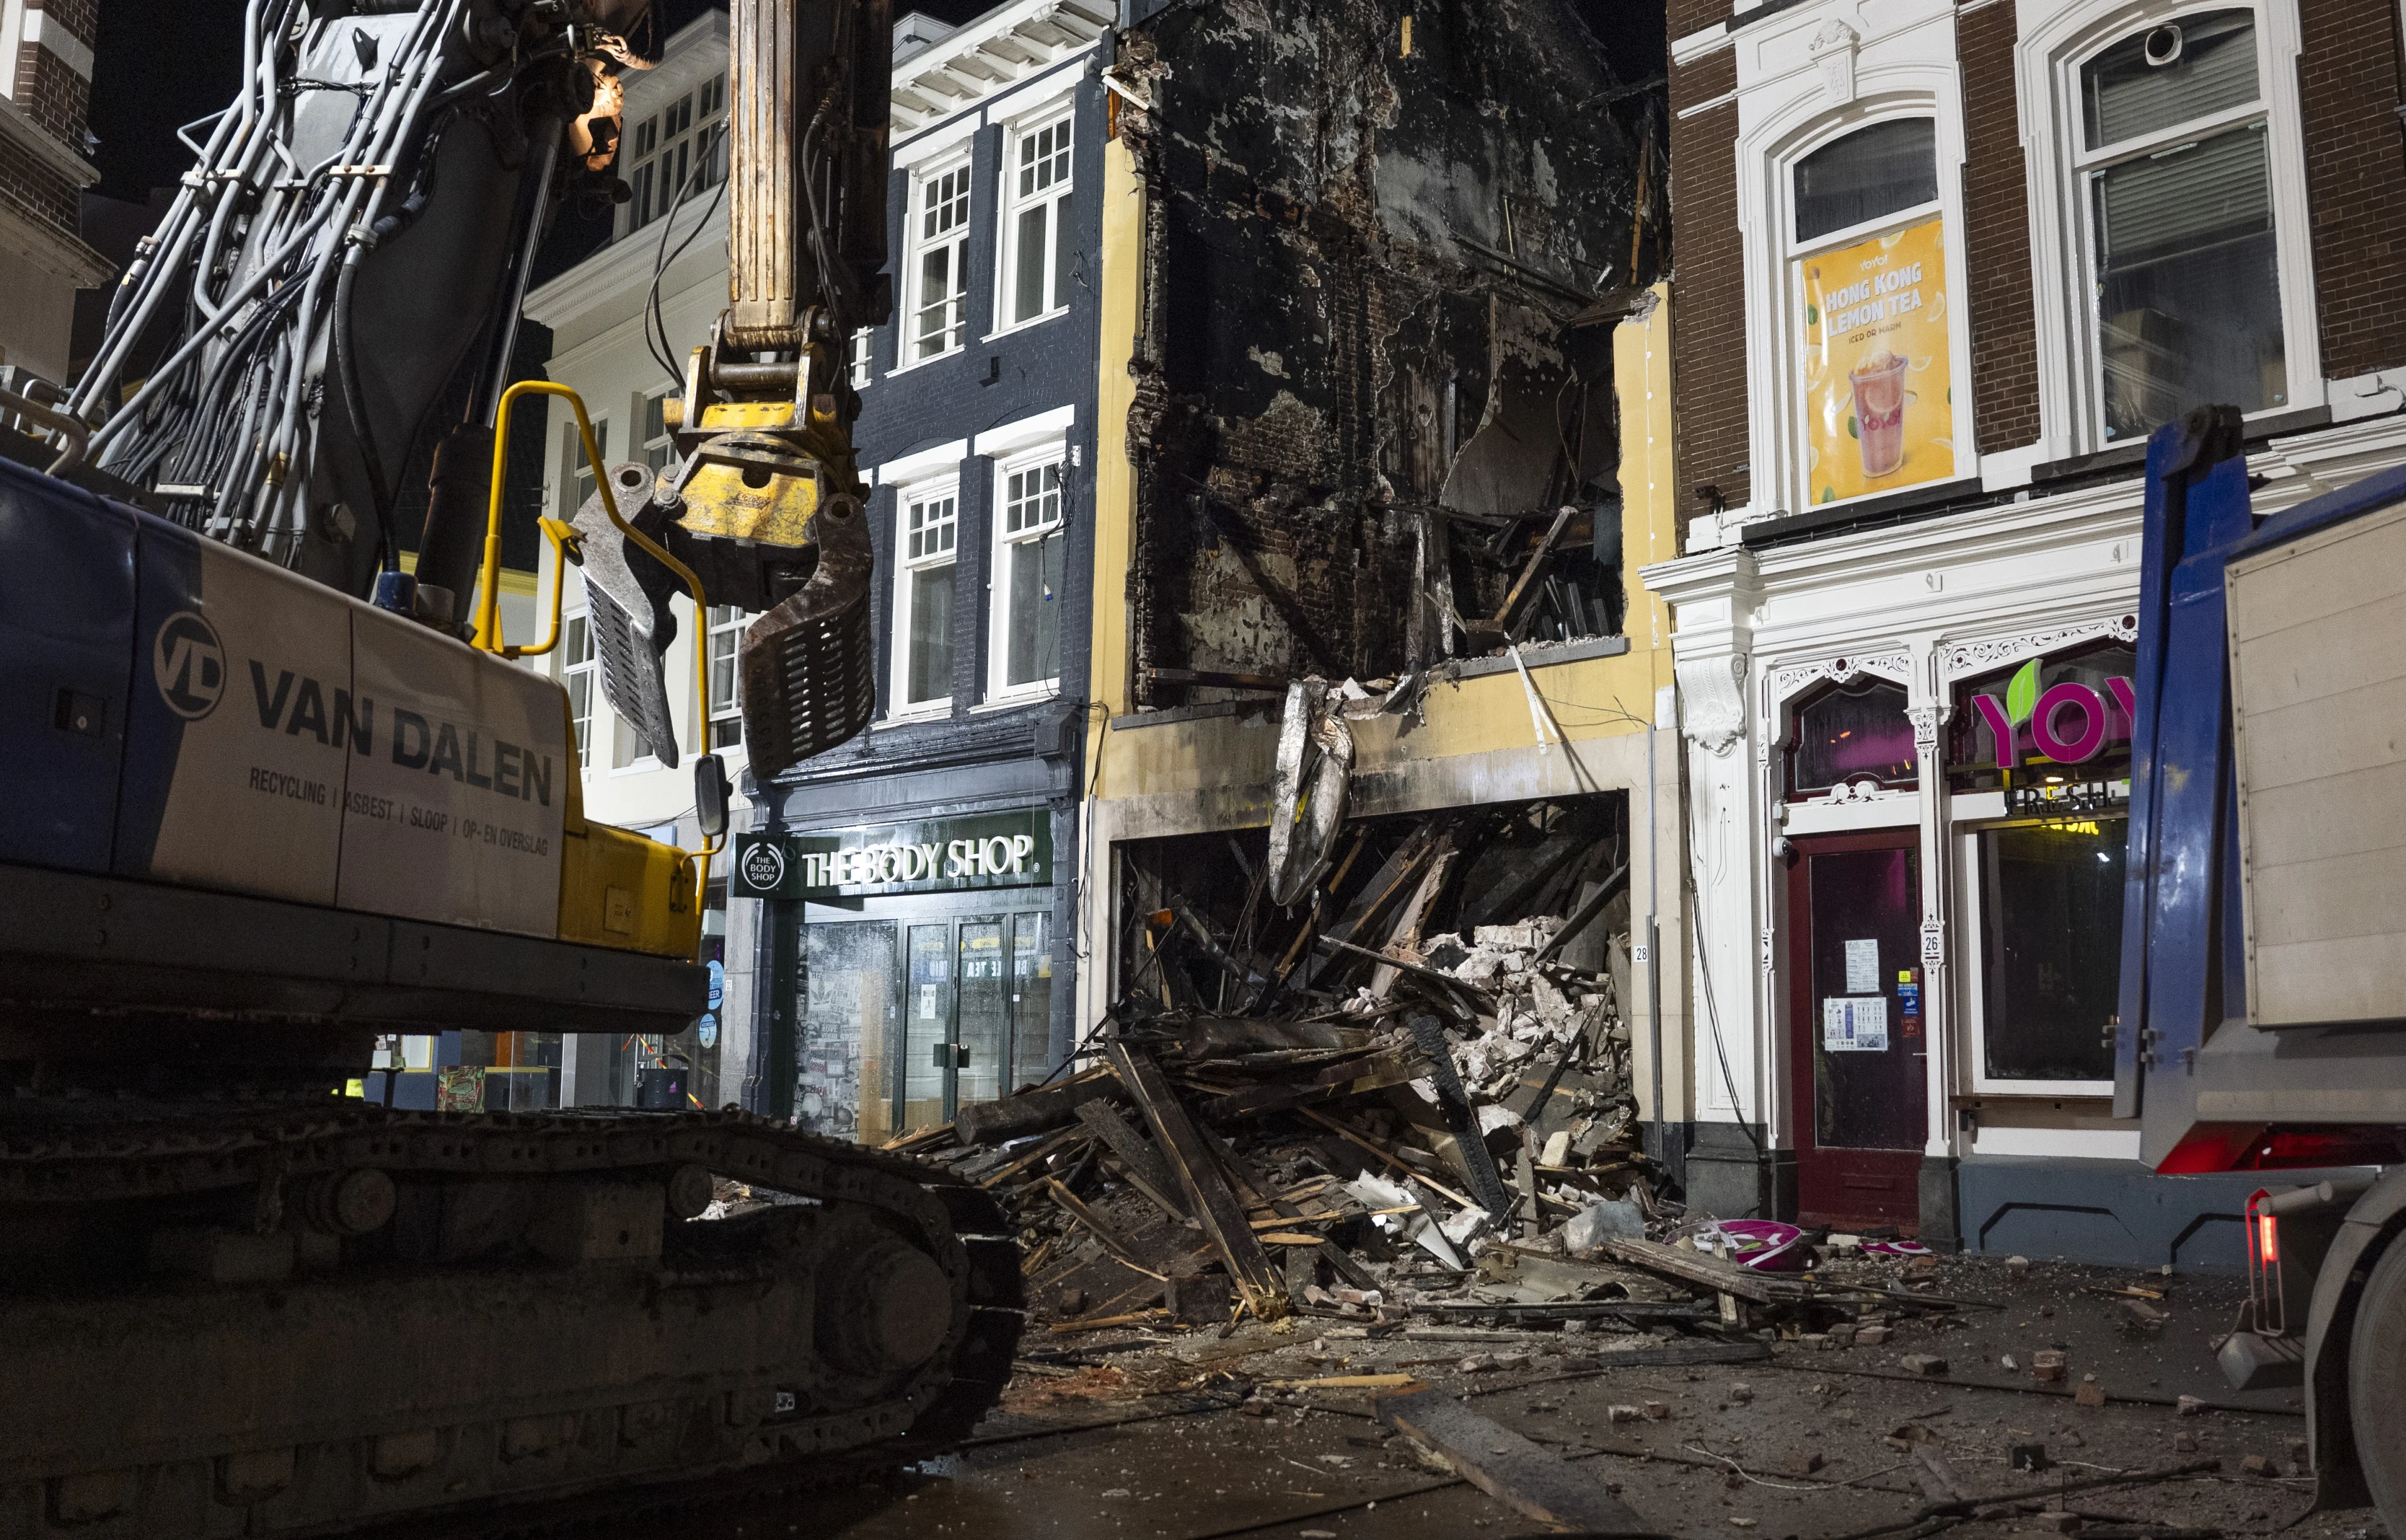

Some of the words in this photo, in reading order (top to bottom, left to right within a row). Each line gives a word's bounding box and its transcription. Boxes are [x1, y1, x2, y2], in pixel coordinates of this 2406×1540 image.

[1826, 279, 1871, 313] HONG
[1874, 262, 1922, 296] KONG
[1828, 300, 1885, 337] LEMON
[1888, 288, 1923, 315] TEA
[1849, 333, 1865, 344] ICED
[1867, 329, 1877, 337] OR
[1878, 321, 1902, 335] WARM
[249, 658, 373, 757] VAN
[392, 707, 552, 807] DALEN
[250, 766, 325, 806] RECYCLING
[343, 789, 393, 820] ASBEST
[410, 806, 447, 832] SLOOP
[462, 818, 481, 838] OP-
[484, 825, 497, 845] EN
[500, 828, 548, 856] OVERSLAG
[2004, 781, 2108, 817] FRESH
[750, 864, 776, 873] BODY
[751, 873, 774, 881] SHOP
[802, 850, 858, 887] THE
[863, 842, 944, 883] BODY
[1637, 947, 1647, 960] 28
[1925, 936, 1938, 951] 26
